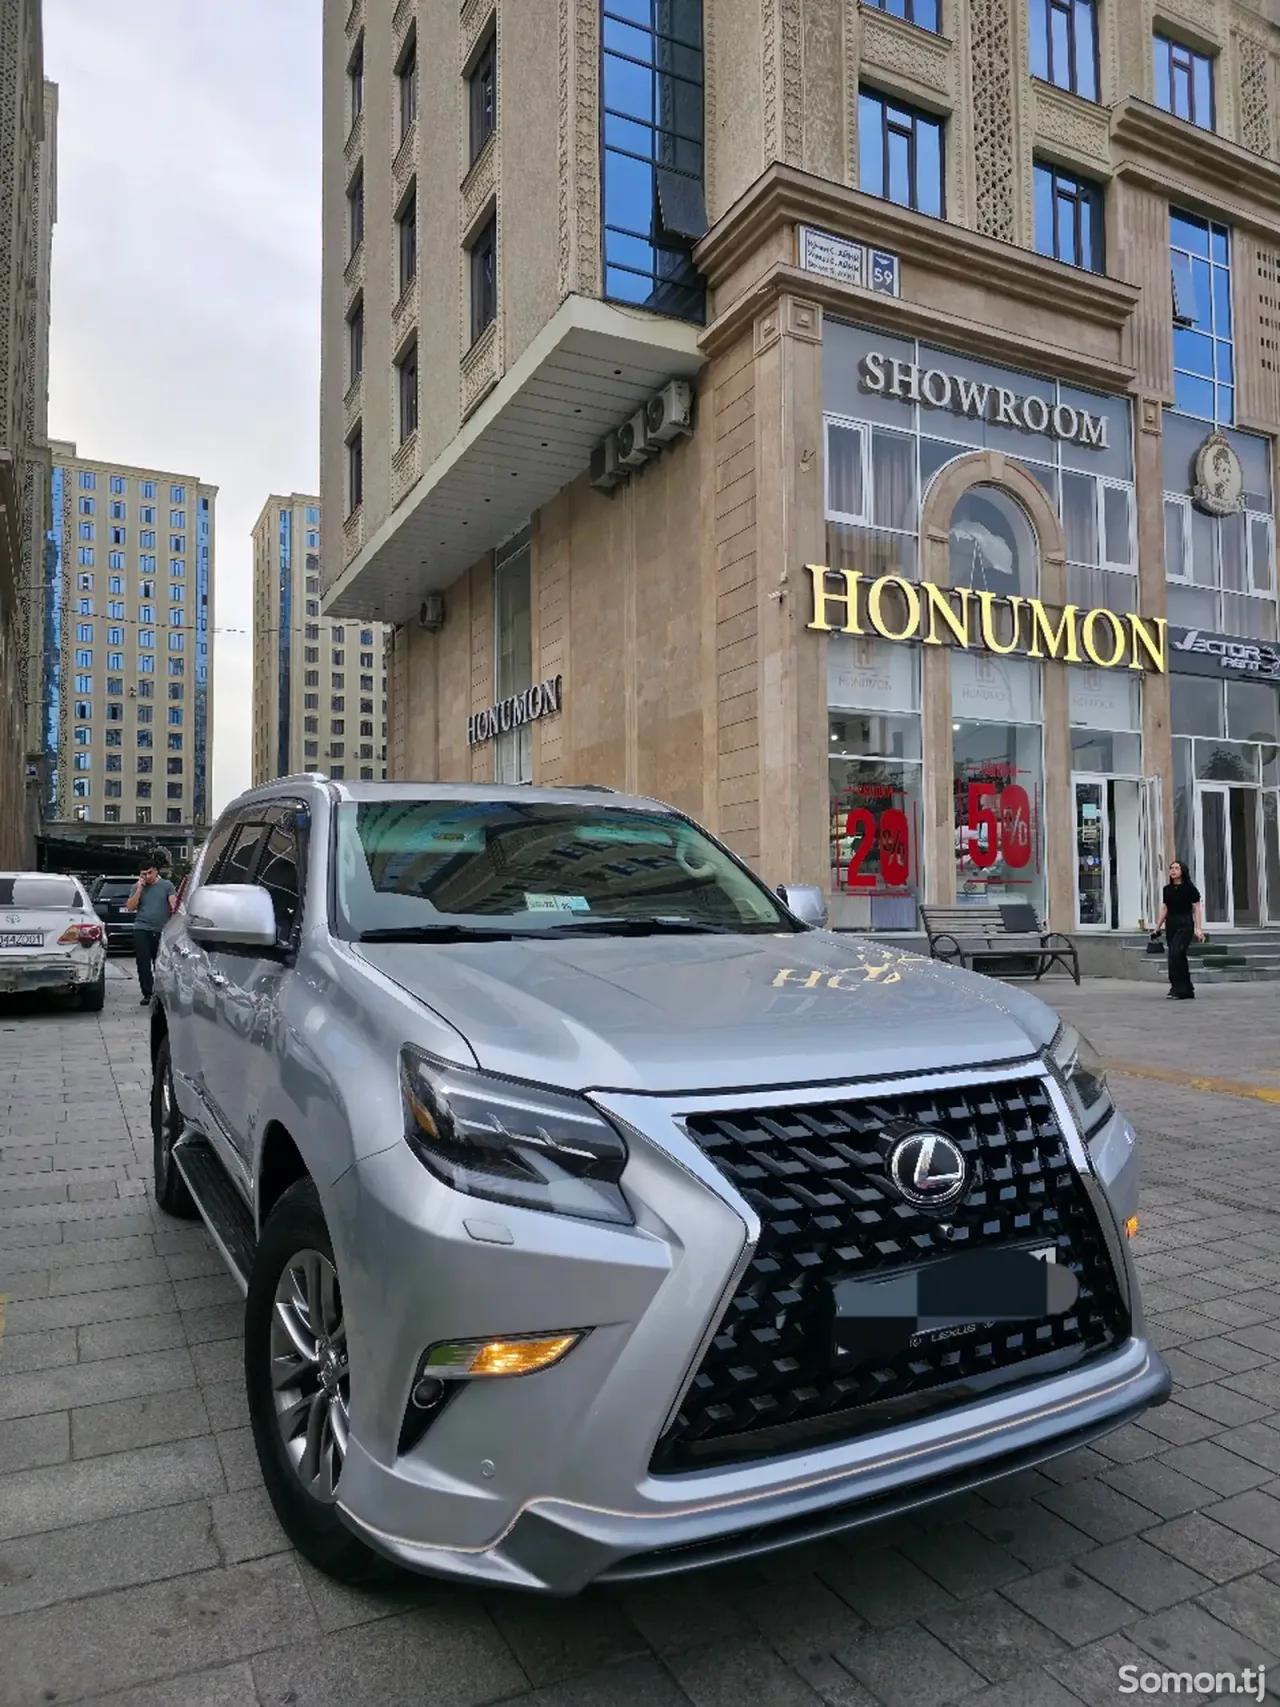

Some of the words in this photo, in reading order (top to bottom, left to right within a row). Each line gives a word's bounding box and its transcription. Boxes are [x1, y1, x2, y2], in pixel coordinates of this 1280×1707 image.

[874, 267, 893, 286] 59
[864, 352, 1110, 449] SHOWROOM
[805, 564, 1168, 673] HONUMON
[467, 674, 562, 745] HONUMON
[931, 1324, 976, 1342] LEXUS
